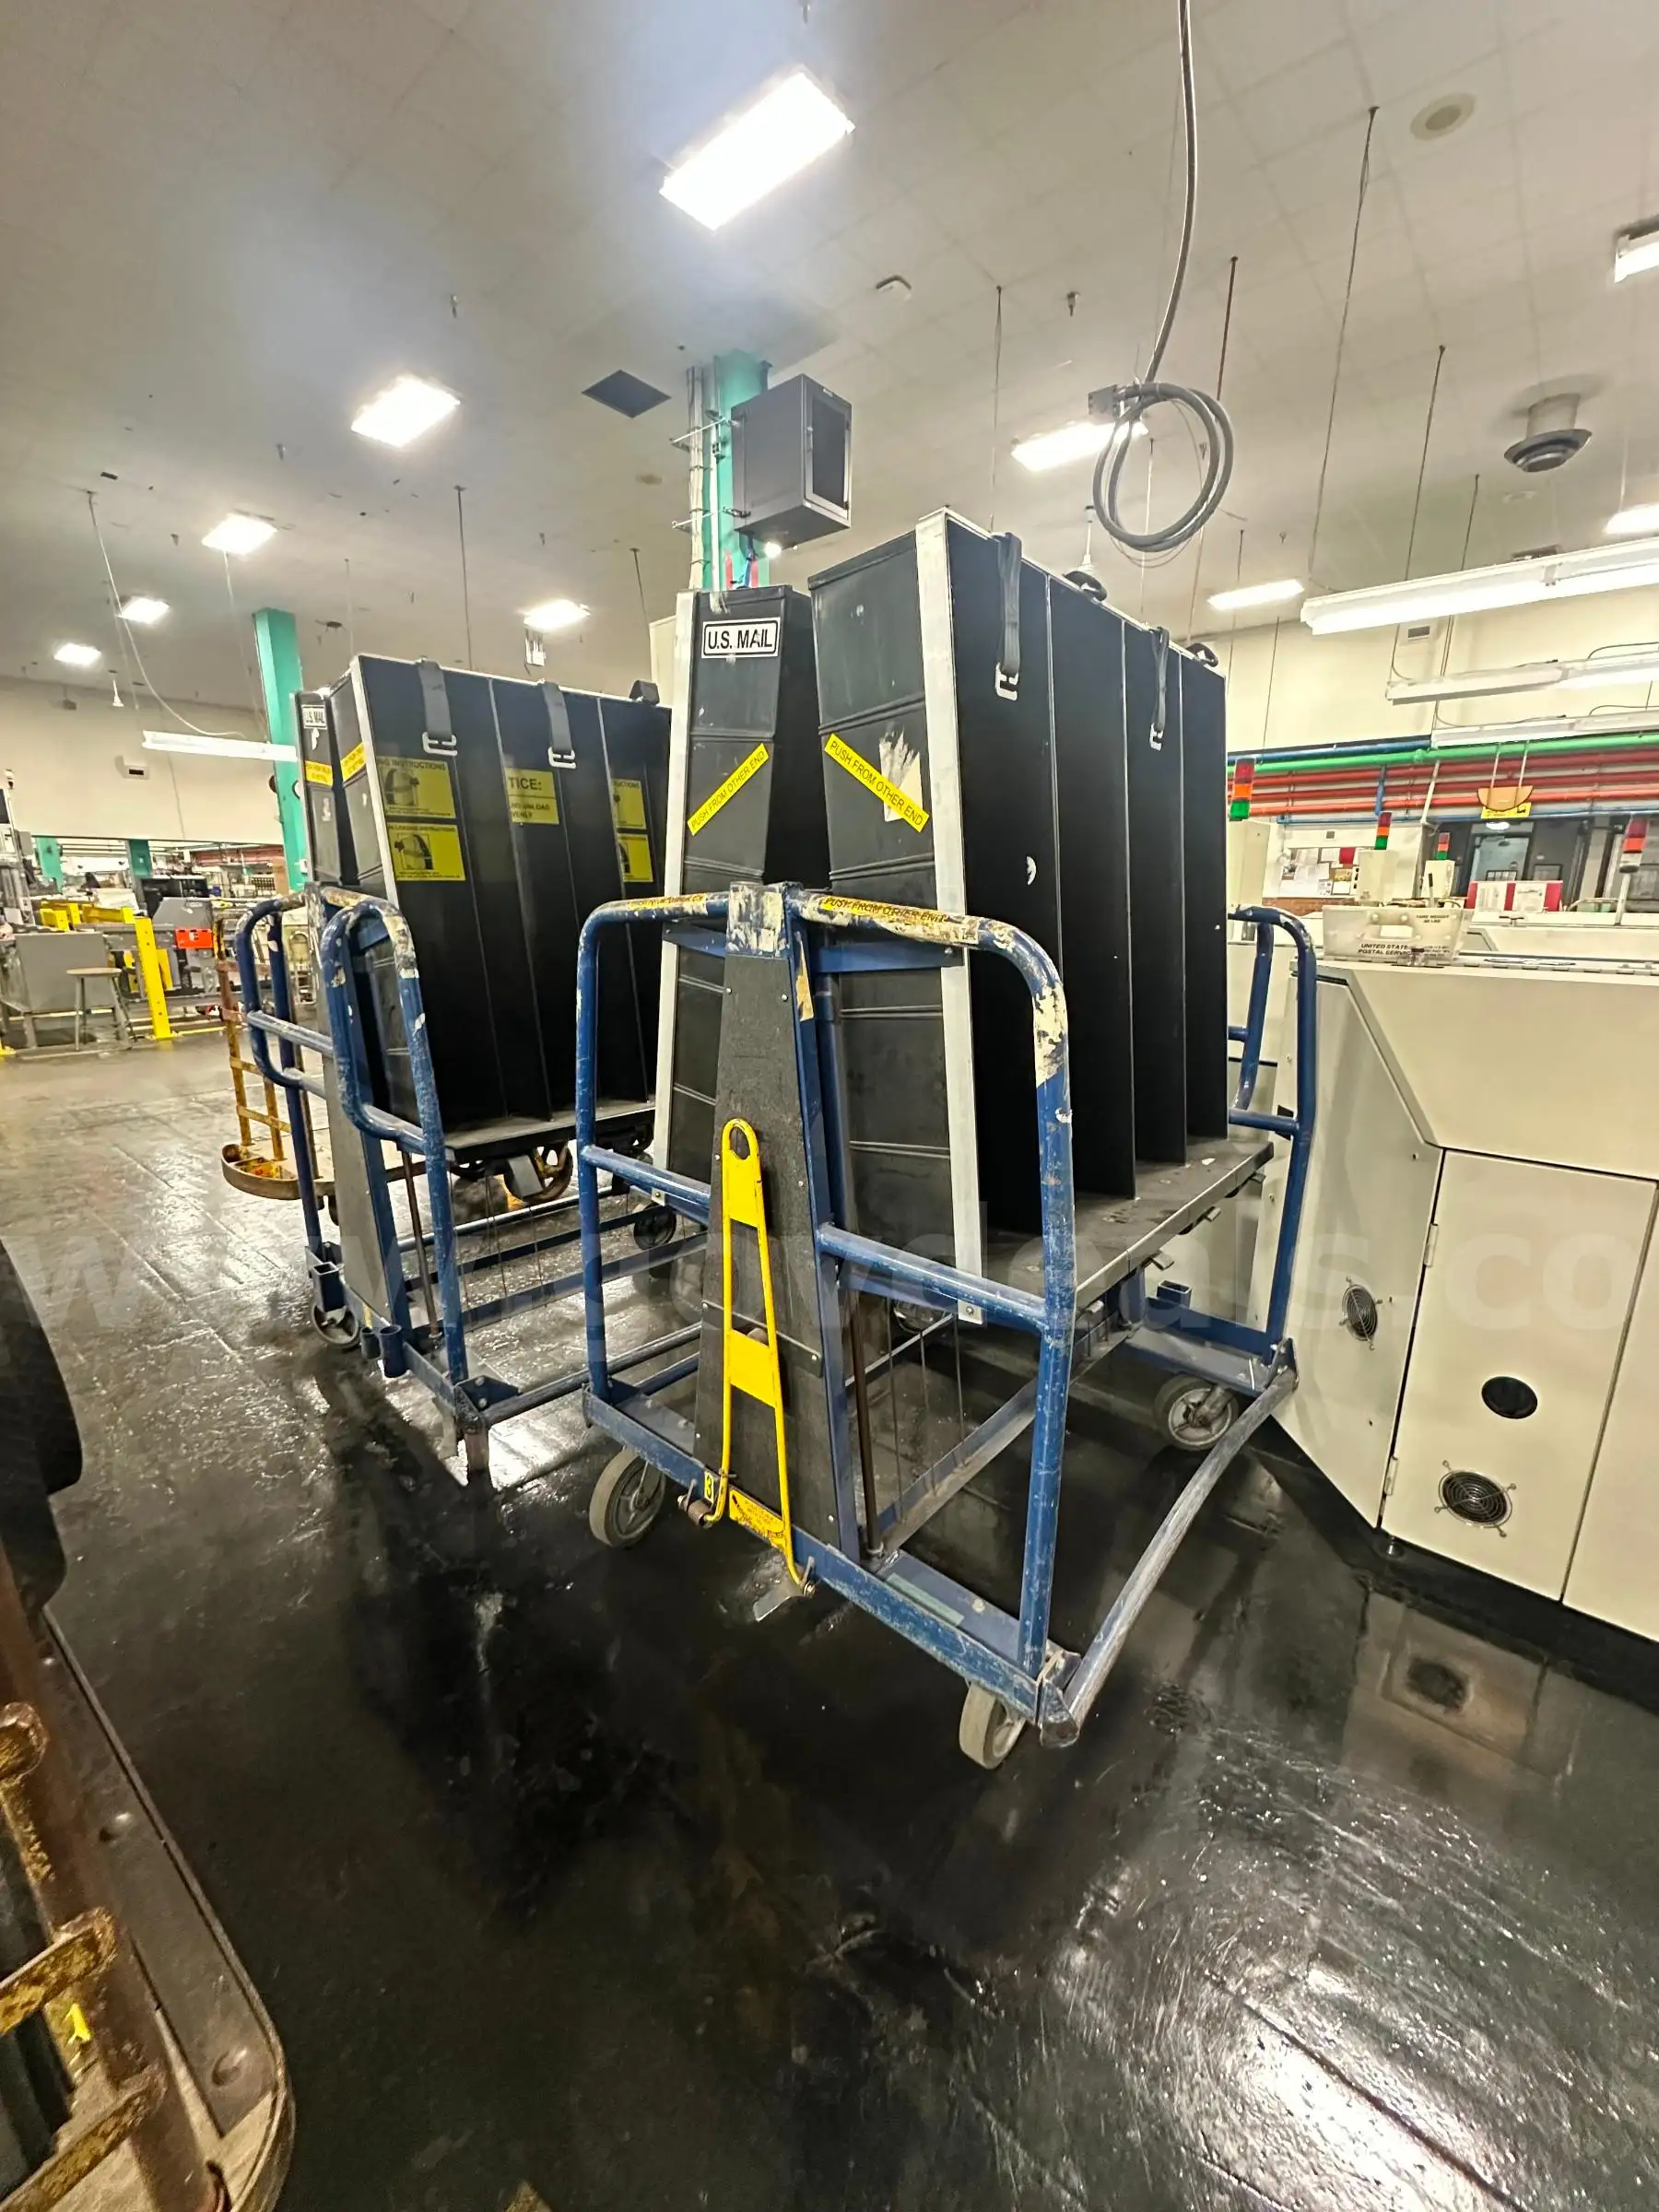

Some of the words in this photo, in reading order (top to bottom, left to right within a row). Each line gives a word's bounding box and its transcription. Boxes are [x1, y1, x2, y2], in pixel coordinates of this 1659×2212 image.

[708, 630, 733, 650] U.S.
[736, 629, 773, 649] MAIL
[509, 776, 542, 791] TICE:
[690, 809, 710, 829] PUSH
[708, 790, 728, 811] FROM
[726, 766, 751, 793] OTHER
[749, 750, 766, 770] END
[830, 740, 853, 765] PUSH
[852, 759, 877, 785] FROM
[876, 781, 904, 811] OTHER
[903, 805, 924, 826] END
[705, 1475, 712, 1500] 3
